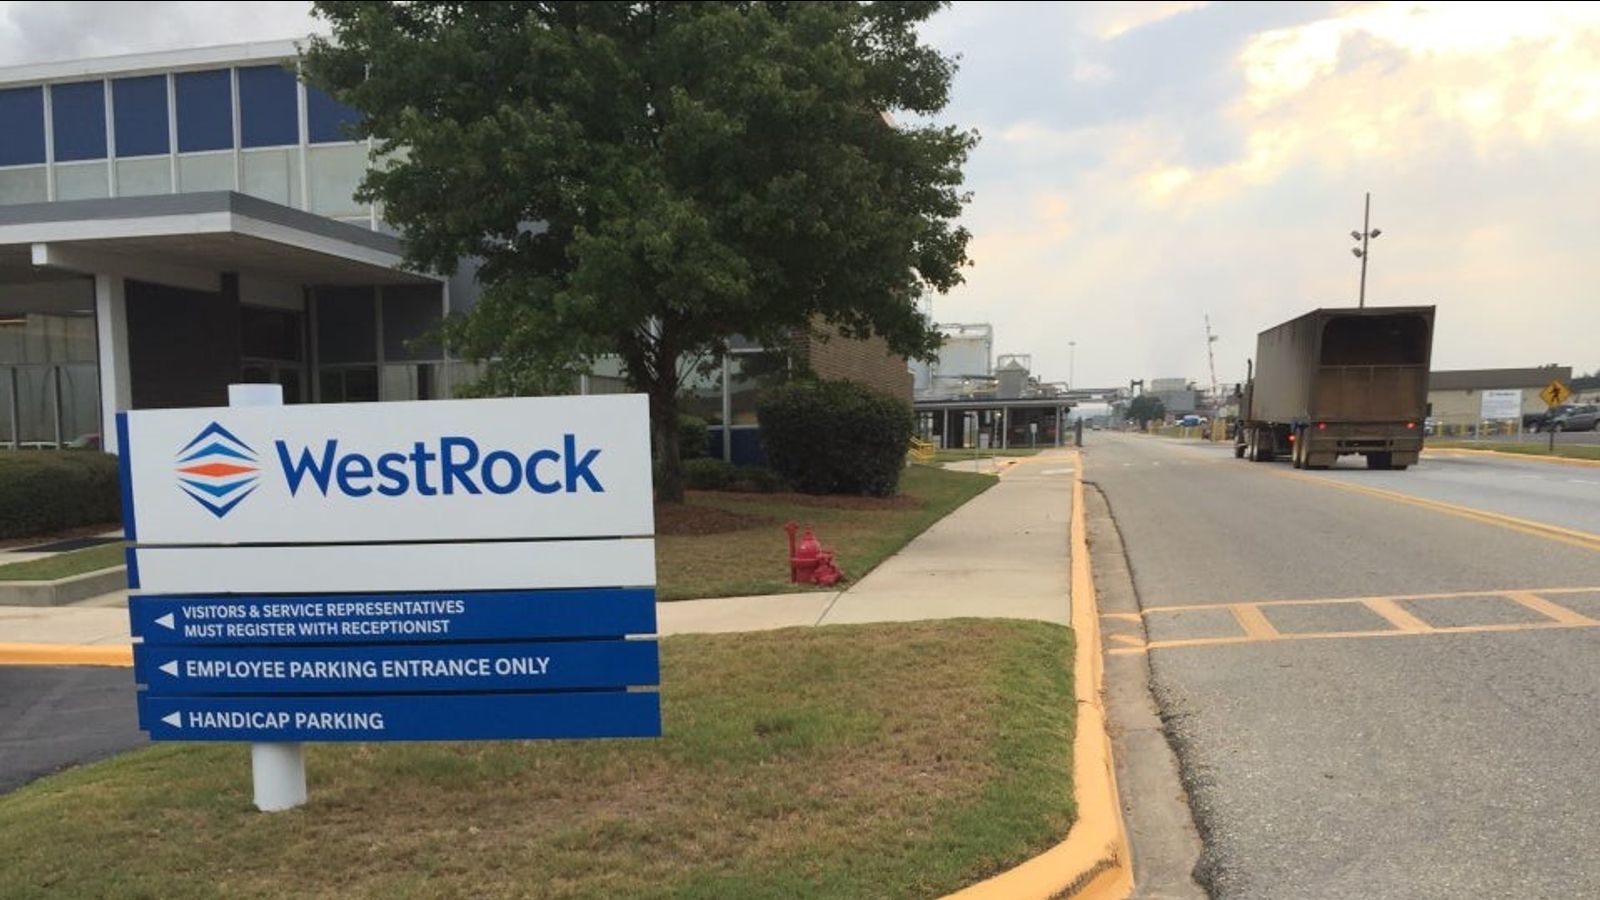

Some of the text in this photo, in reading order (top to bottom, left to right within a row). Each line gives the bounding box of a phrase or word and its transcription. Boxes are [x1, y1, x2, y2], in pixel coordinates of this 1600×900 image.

[275, 433, 605, 498] WestRock
[182, 600, 465, 619] VISITORS & SERVICE REPRESENTATIVES
[184, 619, 450, 637] MUST REGISTER WITH RECEPTIONIST
[186, 657, 550, 678] EMPLOYEE PARKING ENTRANCE ONLY
[189, 711, 384, 730] HANDICAP PARKING
